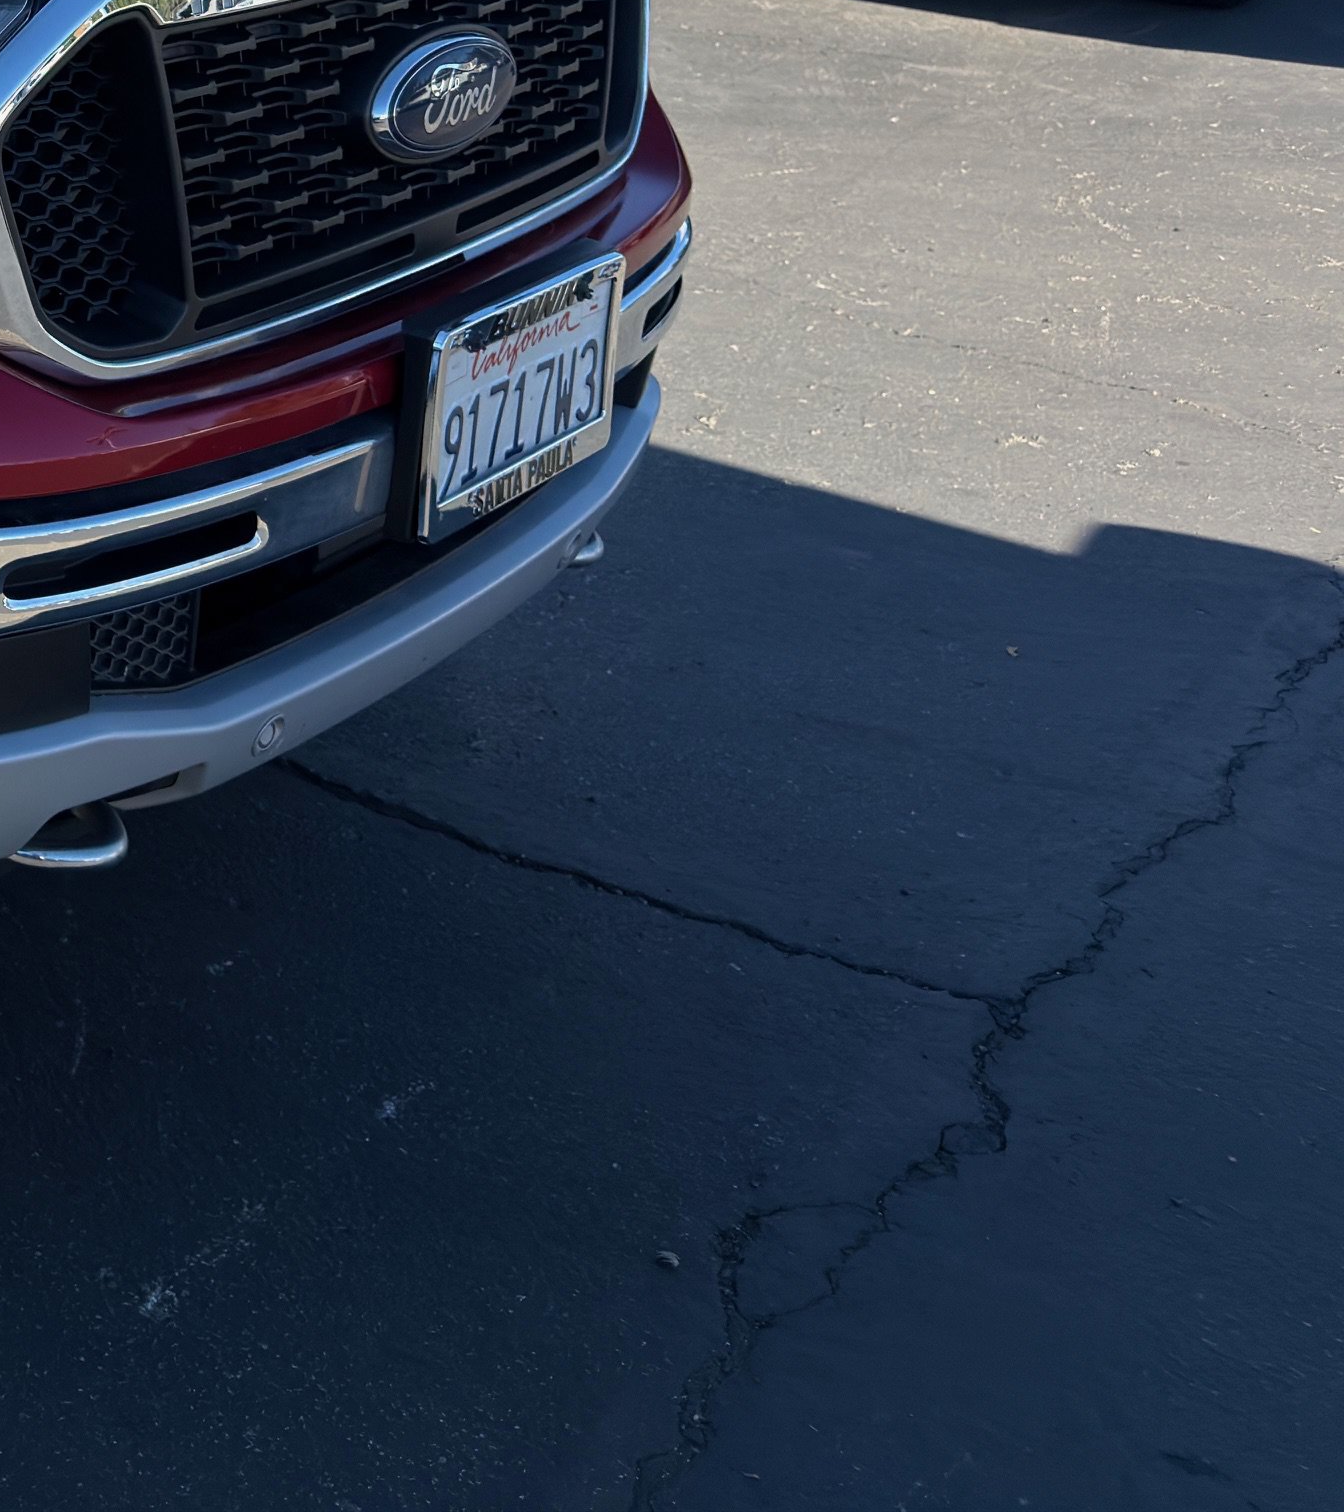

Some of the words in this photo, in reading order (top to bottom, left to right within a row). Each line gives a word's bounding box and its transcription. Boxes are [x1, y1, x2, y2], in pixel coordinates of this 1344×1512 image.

[422, 62, 498, 135] Ford
[471, 310, 580, 380] California
[437, 338, 599, 506] 91717W3
